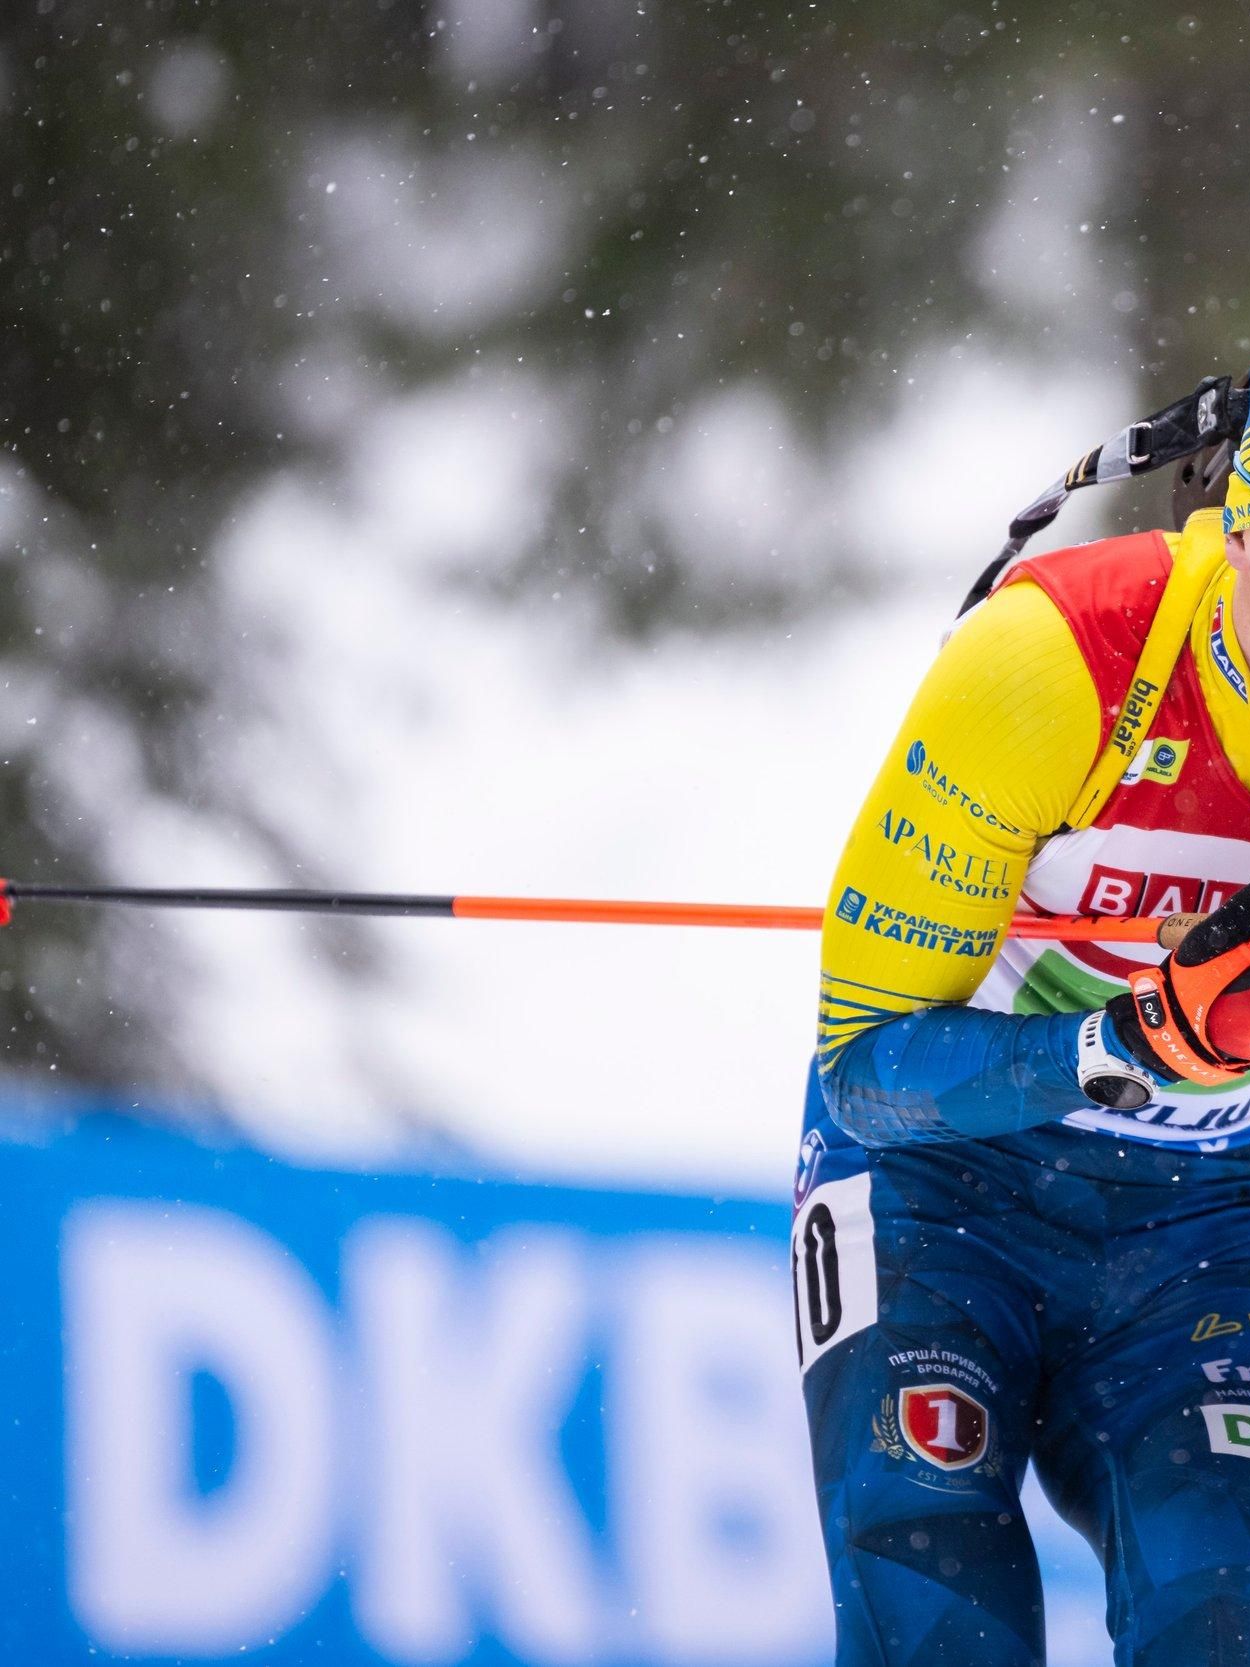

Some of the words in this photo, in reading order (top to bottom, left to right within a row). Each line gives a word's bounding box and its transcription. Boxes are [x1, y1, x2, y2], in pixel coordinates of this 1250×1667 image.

[1113, 678, 1159, 755] biatar
[922, 779, 948, 807] GROUP
[876, 808, 1013, 886] APARTEL
[929, 868, 1010, 900] resorts
[864, 913, 996, 957] КАПІТАЛ
[872, 901, 998, 939] УКРАЇНСЬКИЙ
[888, 1349, 939, 1367] ПЕРША
[941, 1351, 998, 1394] ПРИВАТНА
[916, 1364, 980, 1388] БРОВАРНЯ
[927, 1400, 964, 1452] 1
